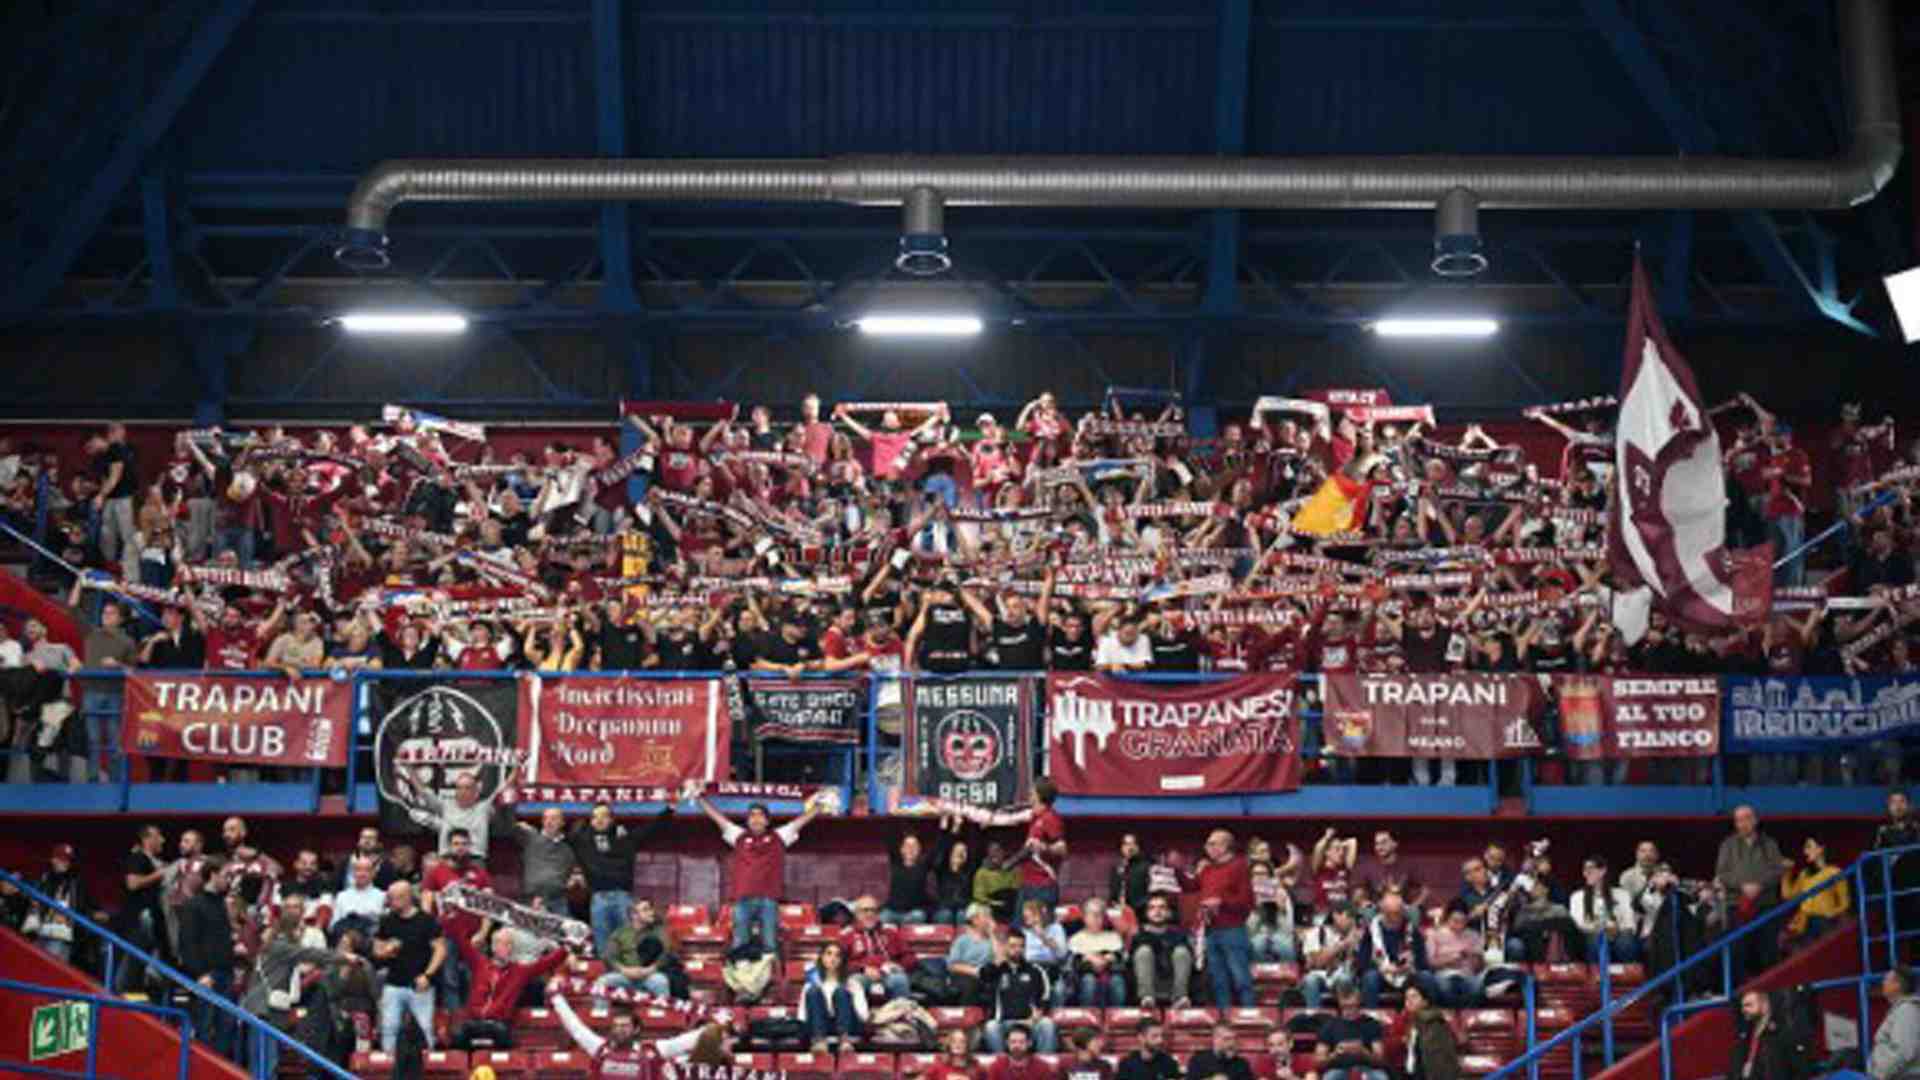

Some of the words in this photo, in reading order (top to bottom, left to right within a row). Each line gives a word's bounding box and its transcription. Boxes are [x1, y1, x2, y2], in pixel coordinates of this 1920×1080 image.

[154, 682, 325, 714] TRAPANI
[916, 685, 1018, 707] NESSUNA
[1361, 680, 1507, 705] TRAPANI
[1612, 679, 1717, 696] SEMPRE
[1616, 704, 1647, 722] AL
[1653, 703, 1706, 721] TUO
[181, 722, 285, 757] CLUB
[1120, 720, 1294, 760] GRANATA
[1617, 730, 1712, 748] FIANCO
[552, 740, 615, 767] Nord
[939, 781, 998, 803] RESA
